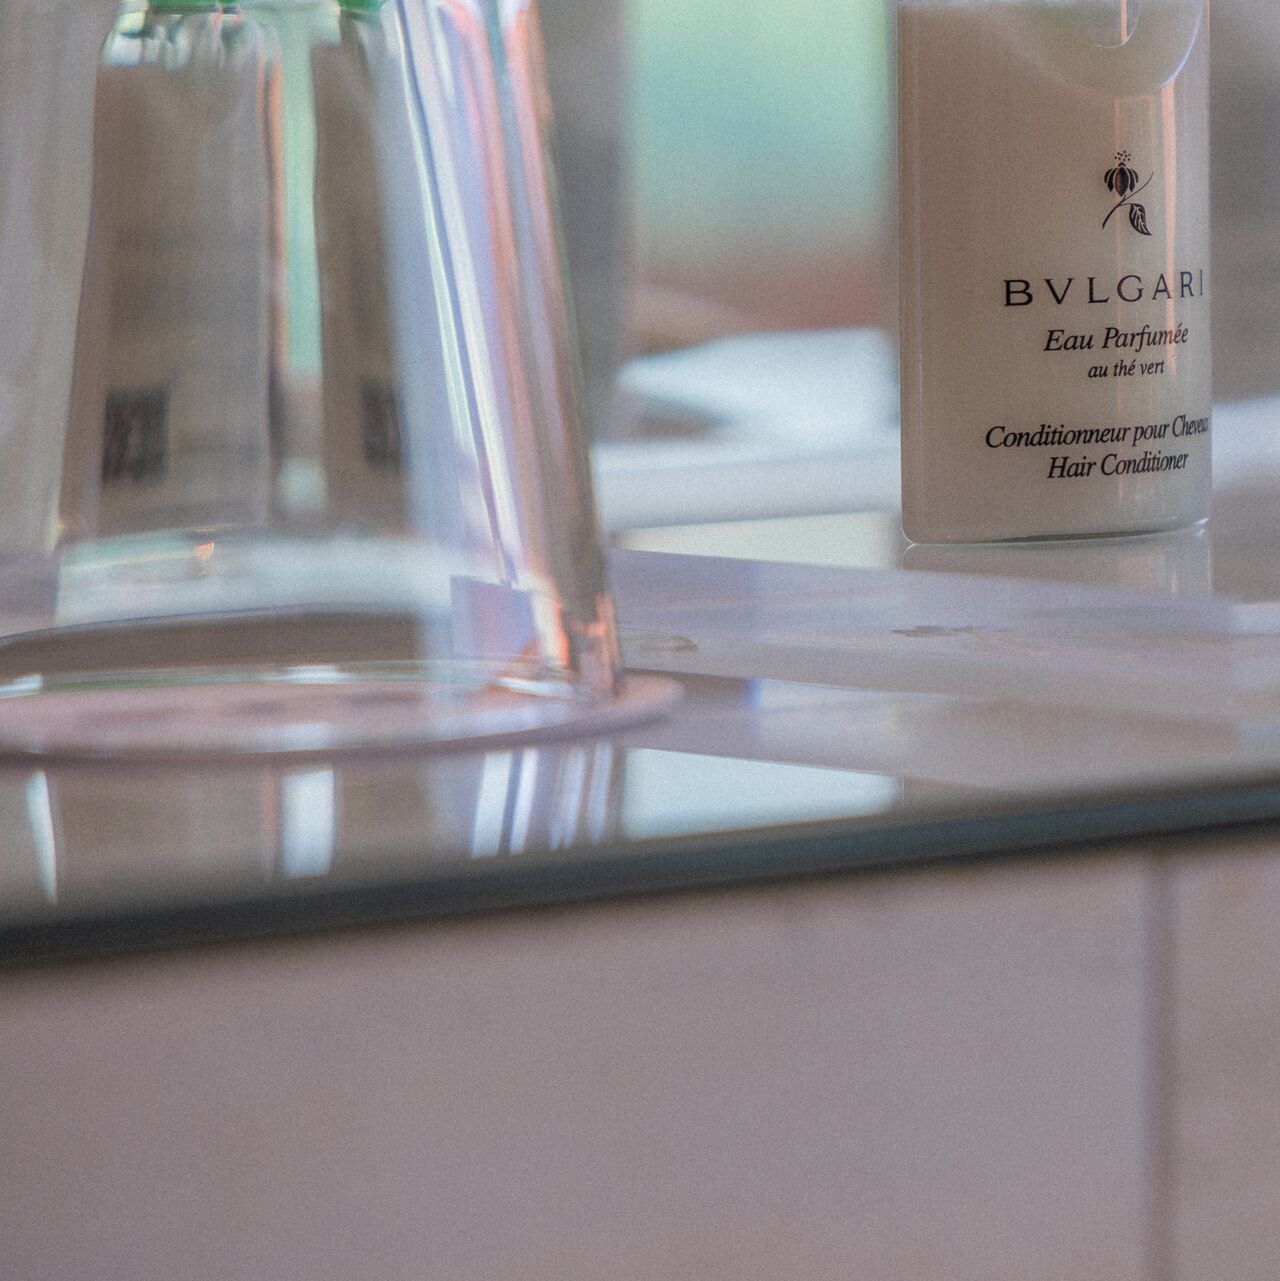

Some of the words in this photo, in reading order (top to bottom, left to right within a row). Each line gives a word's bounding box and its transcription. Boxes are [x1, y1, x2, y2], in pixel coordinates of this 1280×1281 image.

[1002, 269, 1204, 307] BVLGARI
[1043, 328, 1094, 352] Eau
[1101, 322, 1189, 352] Parfumée
[1087, 363, 1108, 379] au
[1112, 358, 1136, 377] thé
[1139, 360, 1165, 375] vert
[985, 423, 1131, 449] Conditionneur
[1131, 423, 1170, 447] pour
[1047, 456, 1097, 479] Hair
[1100, 451, 1189, 476] Conditioner
